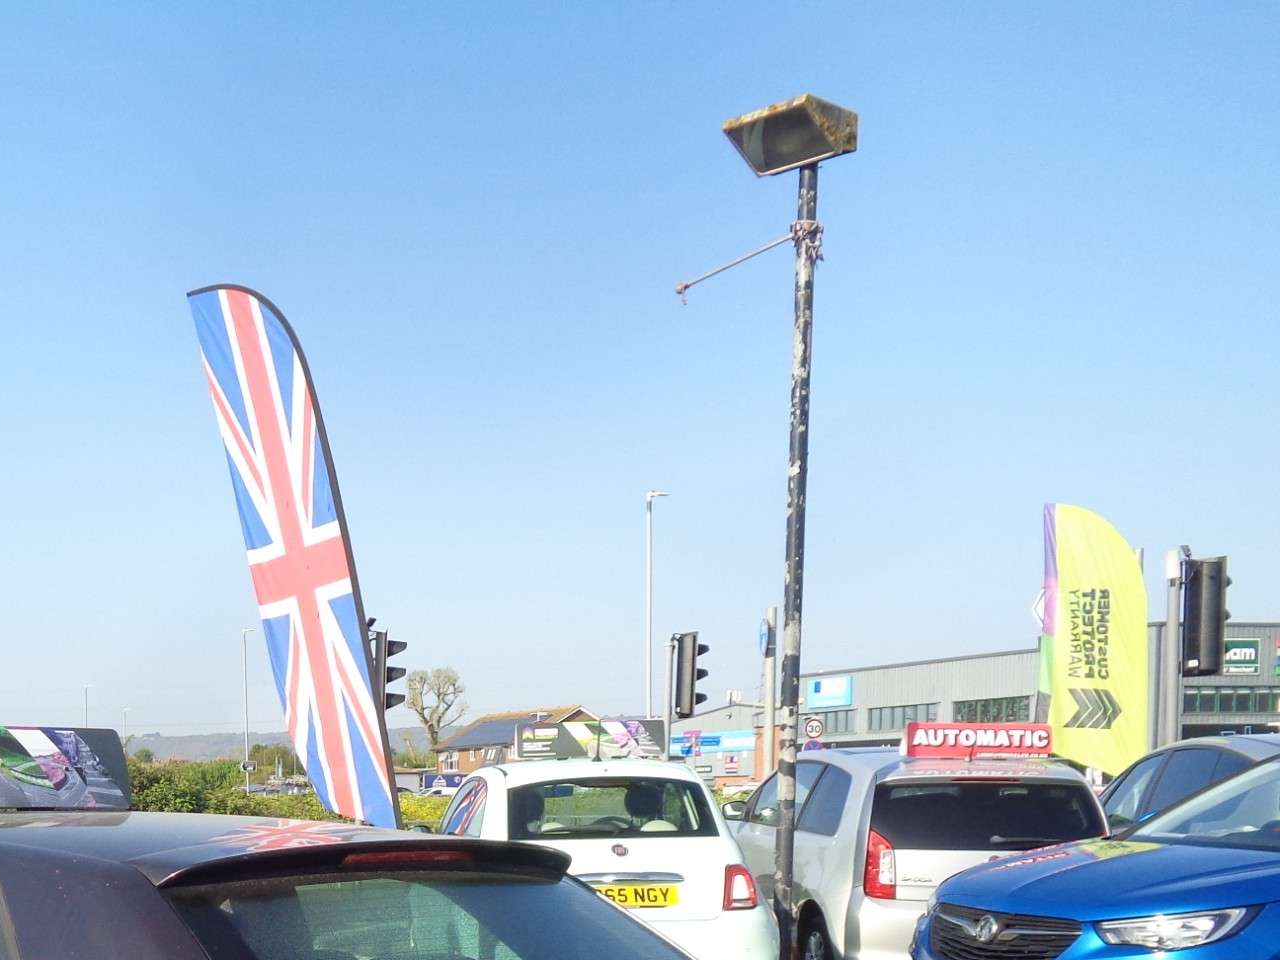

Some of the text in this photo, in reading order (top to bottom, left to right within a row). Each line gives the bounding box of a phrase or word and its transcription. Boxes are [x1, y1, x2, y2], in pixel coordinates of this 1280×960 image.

[807, 724, 821, 734] 30
[912, 728, 1049, 748] AUTOMATIC
[634, 888, 669, 902] NGY
